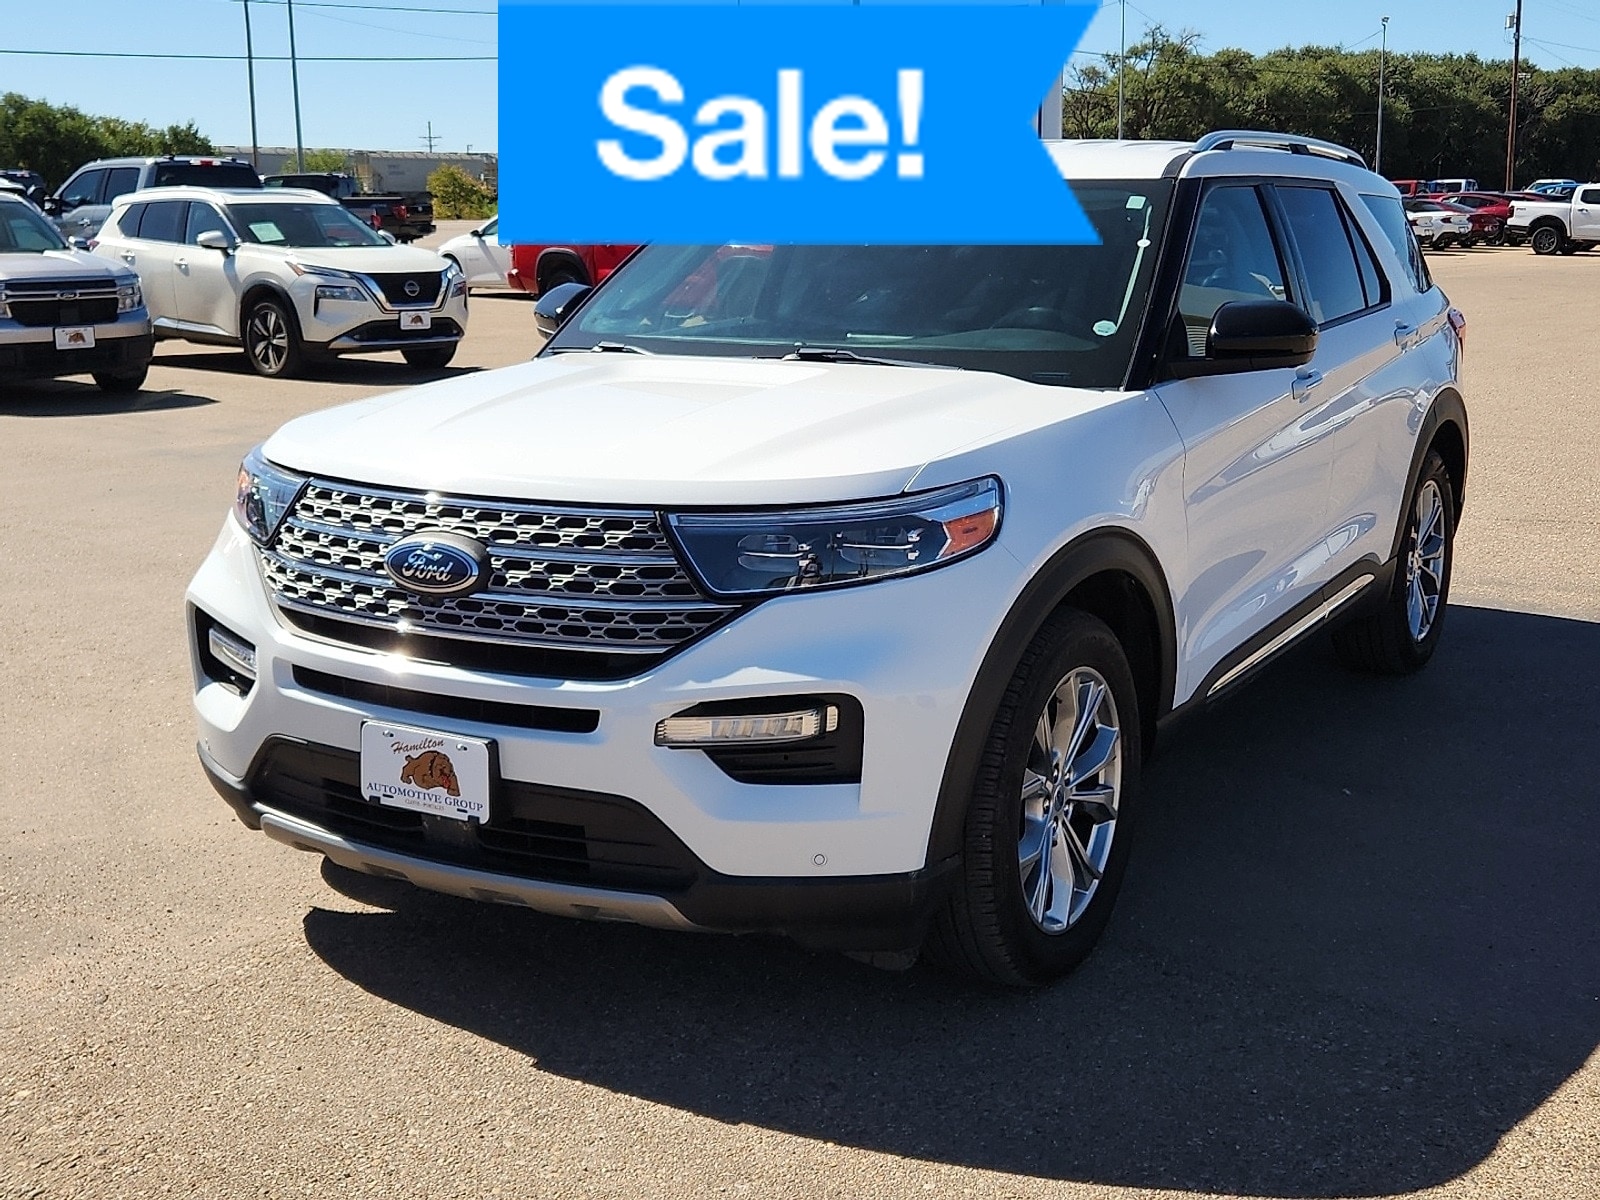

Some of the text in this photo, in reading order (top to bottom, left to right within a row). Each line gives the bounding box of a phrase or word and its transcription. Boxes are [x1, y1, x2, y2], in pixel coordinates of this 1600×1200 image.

[402, 549, 453, 581] Ford
[391, 738, 445, 755] Hamilton
[366, 782, 442, 804] AUTOMOTIVE
[444, 797, 484, 812] GROUP
